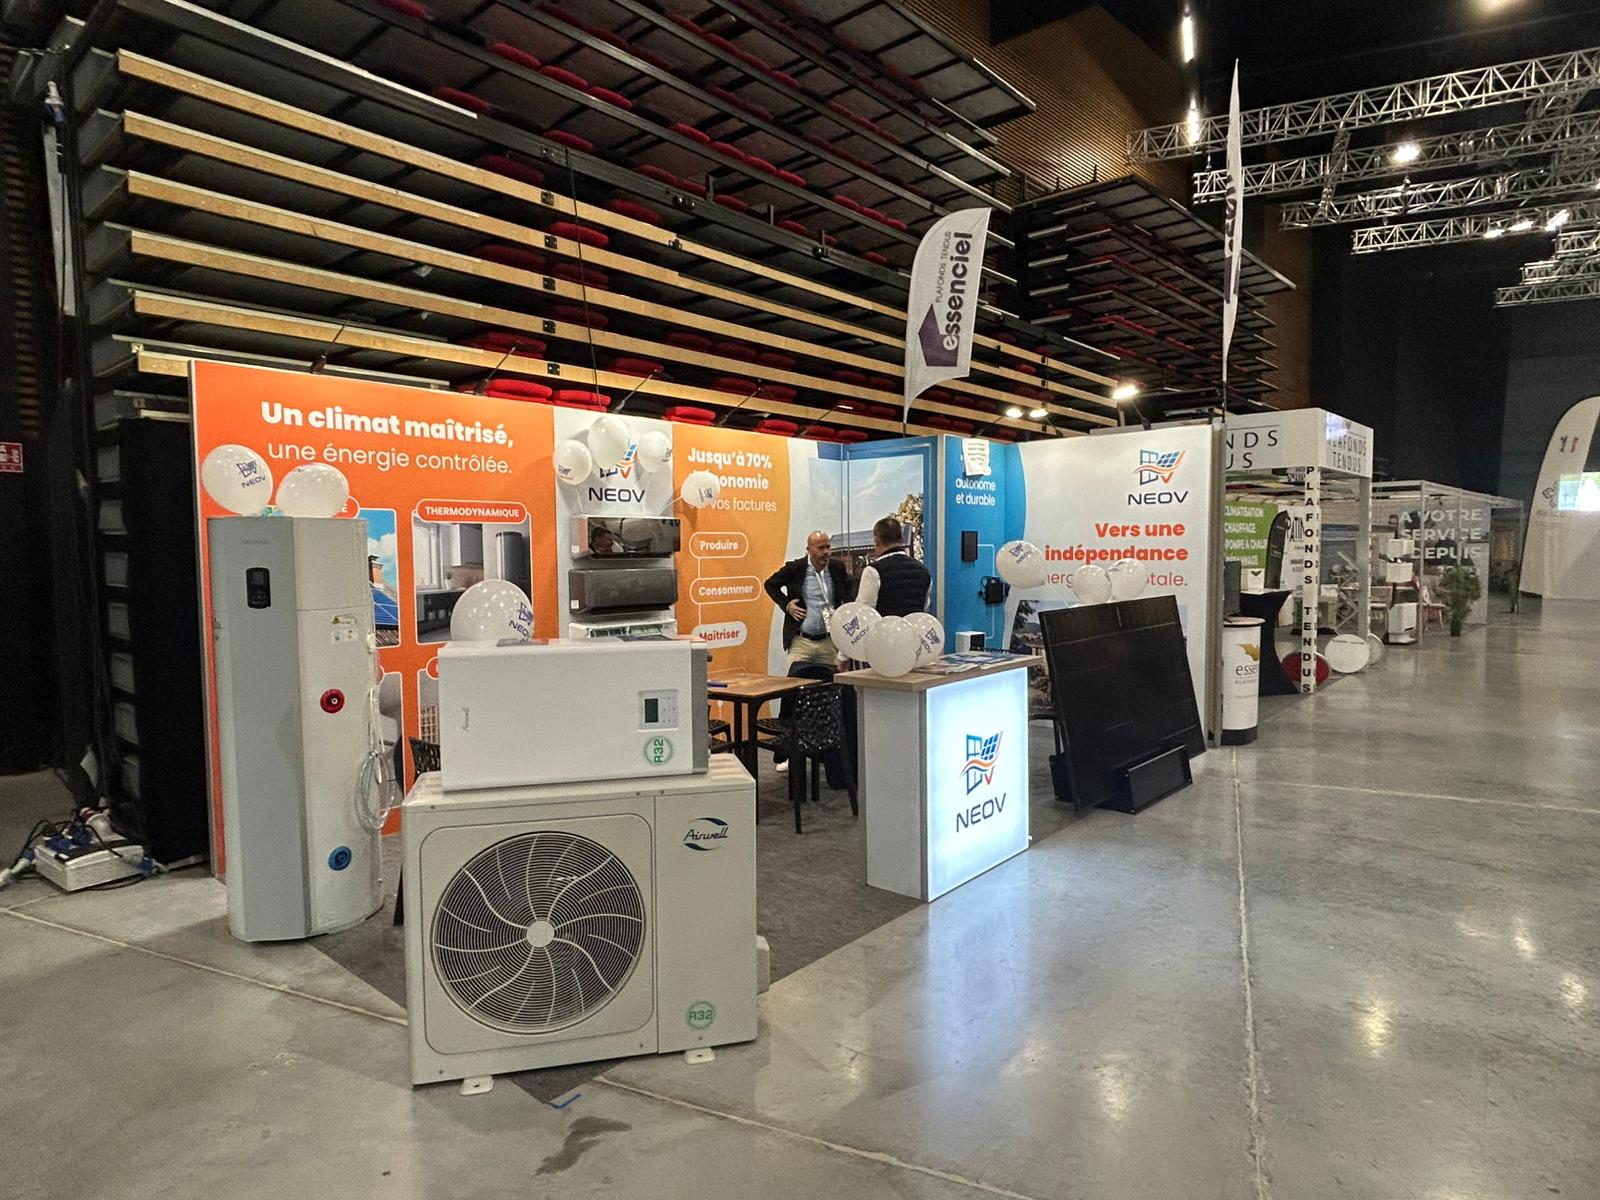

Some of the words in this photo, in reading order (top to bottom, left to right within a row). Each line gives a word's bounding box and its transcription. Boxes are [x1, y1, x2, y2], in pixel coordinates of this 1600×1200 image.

[935, 262, 946, 303] PLAFONDS
[943, 231, 973, 351] essenciel
[260, 401, 303, 427] Un
[308, 406, 400, 436] climat
[404, 415, 514, 448] maîtrisé,
[268, 442, 316, 461] une
[323, 443, 410, 471] énergie
[415, 450, 513, 474] contrôlée.
[687, 448, 744, 471] Jusqu'à
[746, 452, 773, 469] 70%
[241, 474, 266, 488] NEOV
[719, 473, 769, 490] onomie
[955, 478, 996, 491] autonome
[588, 486, 645, 503] NEOV
[955, 492, 965, 505] et
[966, 493, 996, 506] durable
[1128, 491, 1189, 506] NEOV
[424, 505, 520, 518] THERMODYNAMIQUE
[711, 498, 730, 510] vos
[733, 497, 777, 512] factures
[1418, 508, 1483, 522] VOTRE
[1095, 523, 1140, 538] Vers
[1145, 525, 1185, 537] une
[1303, 466, 1315, 584] PLAFONDS
[1400, 528, 1482, 541] SERVICE
[700, 540, 738, 551] Produire
[1045, 545, 1188, 565] indépendance
[1145, 571, 1188, 586] tale.
[699, 585, 753, 597] Consommer
[699, 628, 740, 641] Maîtriser
[1302, 606, 1312, 693] TENDUS
[653, 738, 665, 764] R32
[956, 792, 1006, 833] NEOV
[683, 827, 729, 840] Airwell
[688, 1010, 713, 1021] R32
